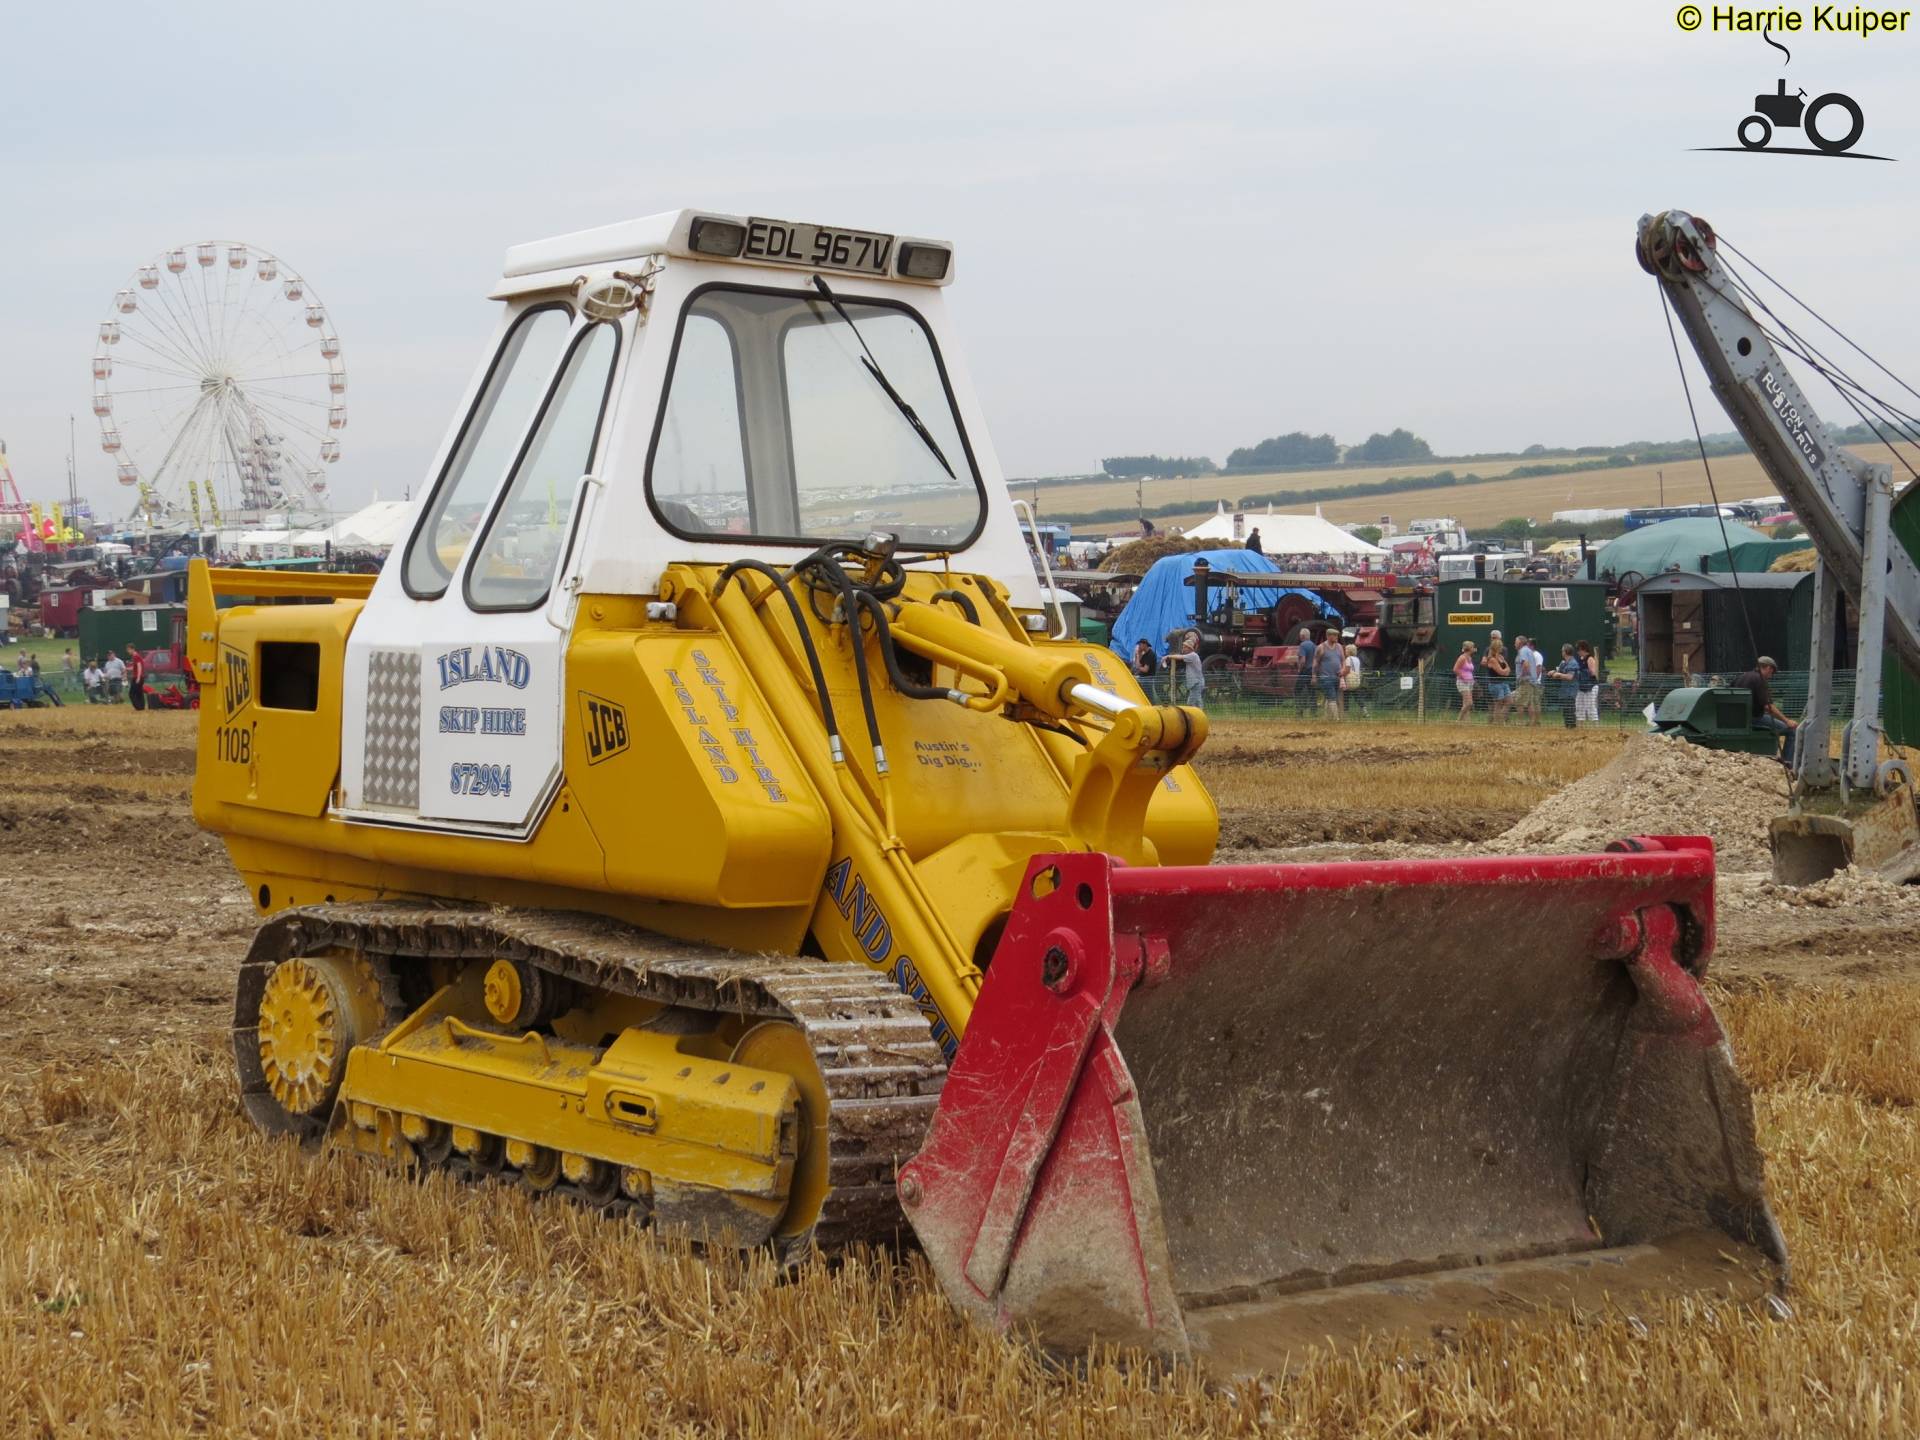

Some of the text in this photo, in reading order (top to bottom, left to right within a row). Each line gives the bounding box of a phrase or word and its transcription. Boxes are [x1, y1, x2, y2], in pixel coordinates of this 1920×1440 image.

[748, 223, 891, 269] EDL 967V
[1761, 371, 1804, 428] RUSTON
[1771, 393, 1817, 464] BUCYRUS
[225, 651, 250, 714] JCB
[437, 645, 531, 691] ISLAND
[439, 706, 527, 735] SKIP HIRE
[587, 700, 627, 758] JCB
[664, 669, 738, 783] ISLAND
[690, 649, 788, 802] SKIP HIRE
[216, 726, 251, 764] 110B
[914, 741, 970, 751] Austin's
[917, 754, 943, 768] Dig
[450, 762, 512, 796] 872984
